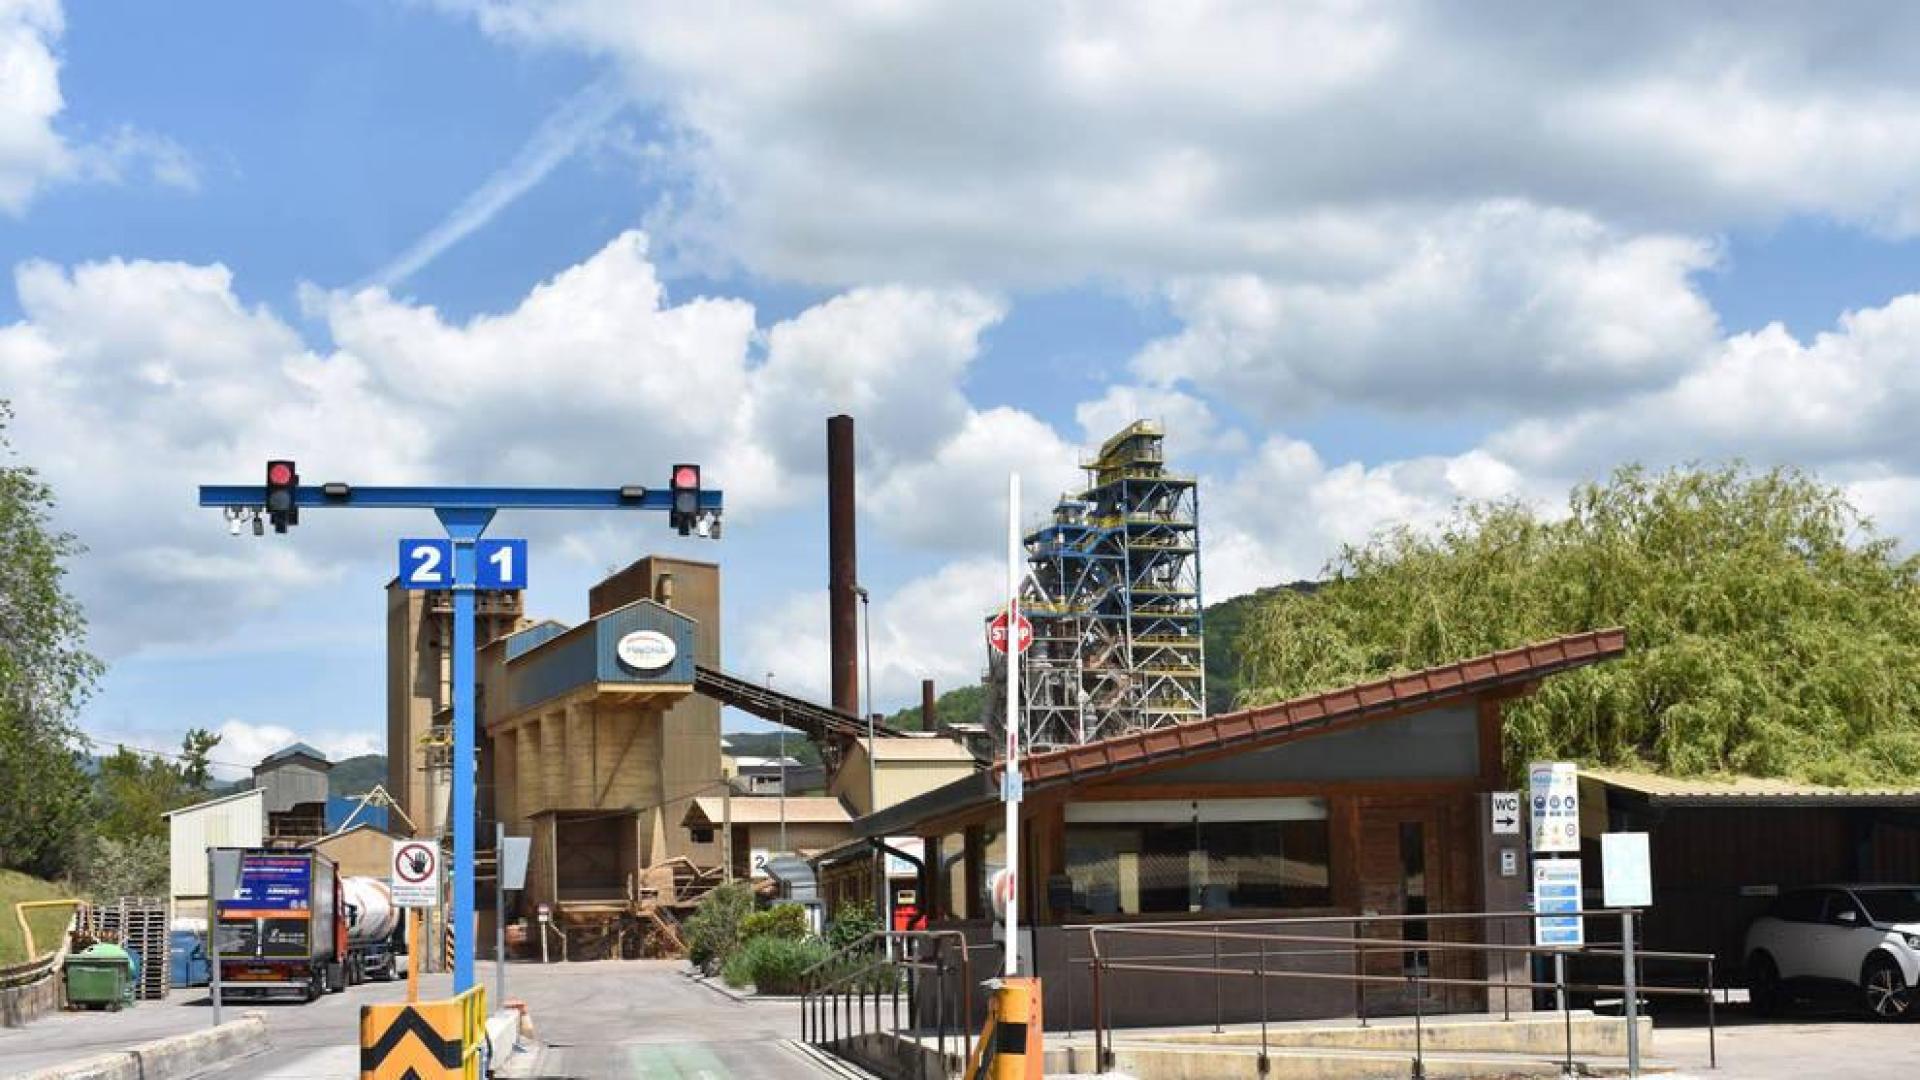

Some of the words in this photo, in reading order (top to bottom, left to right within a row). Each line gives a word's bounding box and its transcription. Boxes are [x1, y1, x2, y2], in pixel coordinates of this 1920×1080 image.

[410, 546, 441, 583] 2
[490, 546, 513, 583] 1
[992, 626, 1029, 641] STP
[1494, 798, 1518, 811] WC
